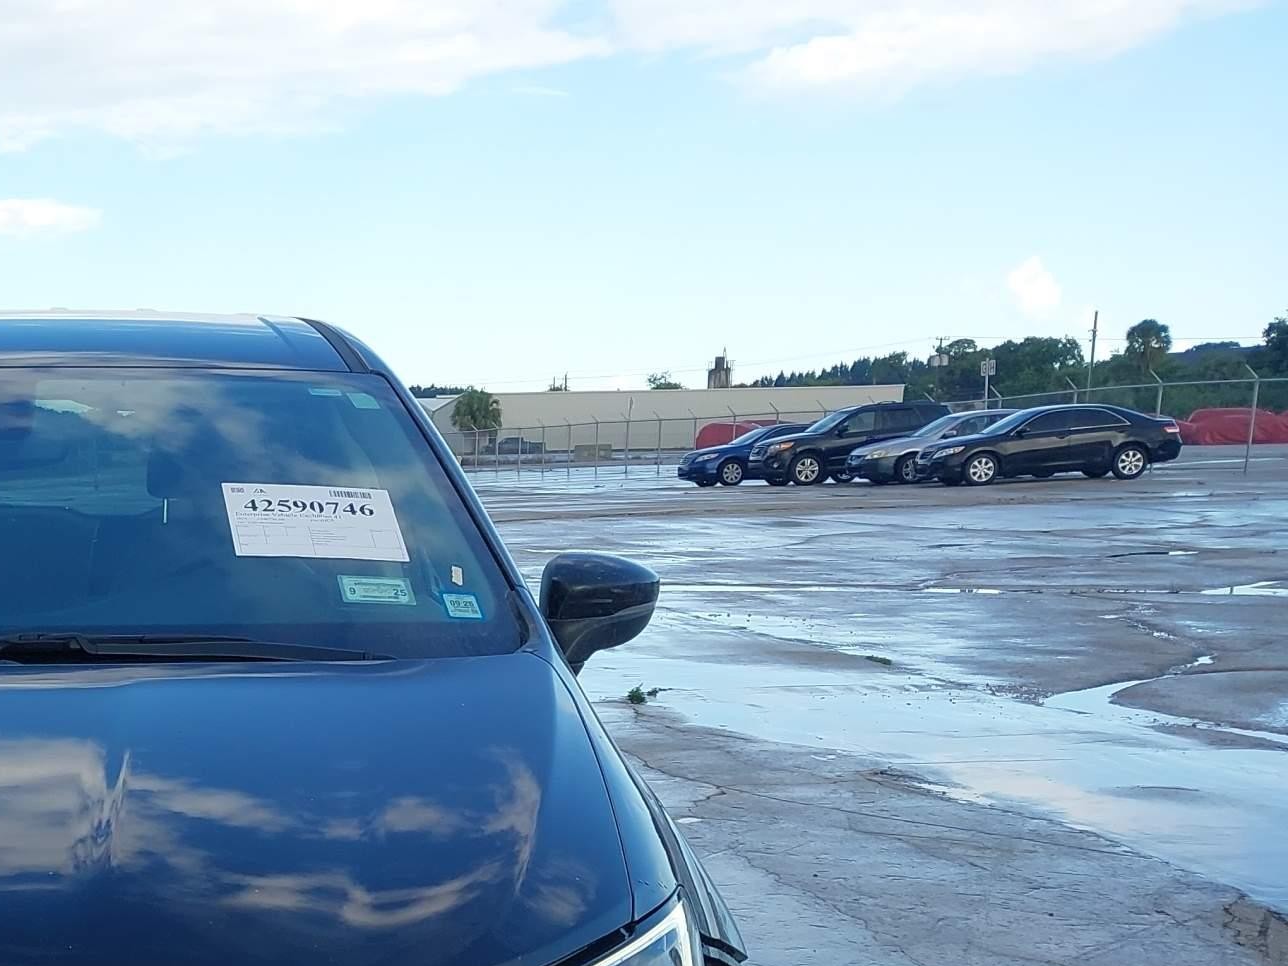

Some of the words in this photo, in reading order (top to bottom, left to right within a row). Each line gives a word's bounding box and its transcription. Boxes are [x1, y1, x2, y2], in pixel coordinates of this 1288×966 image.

[244, 498, 374, 517] 42590746
[349, 587, 357, 596] 9
[393, 588, 407, 597] 25
